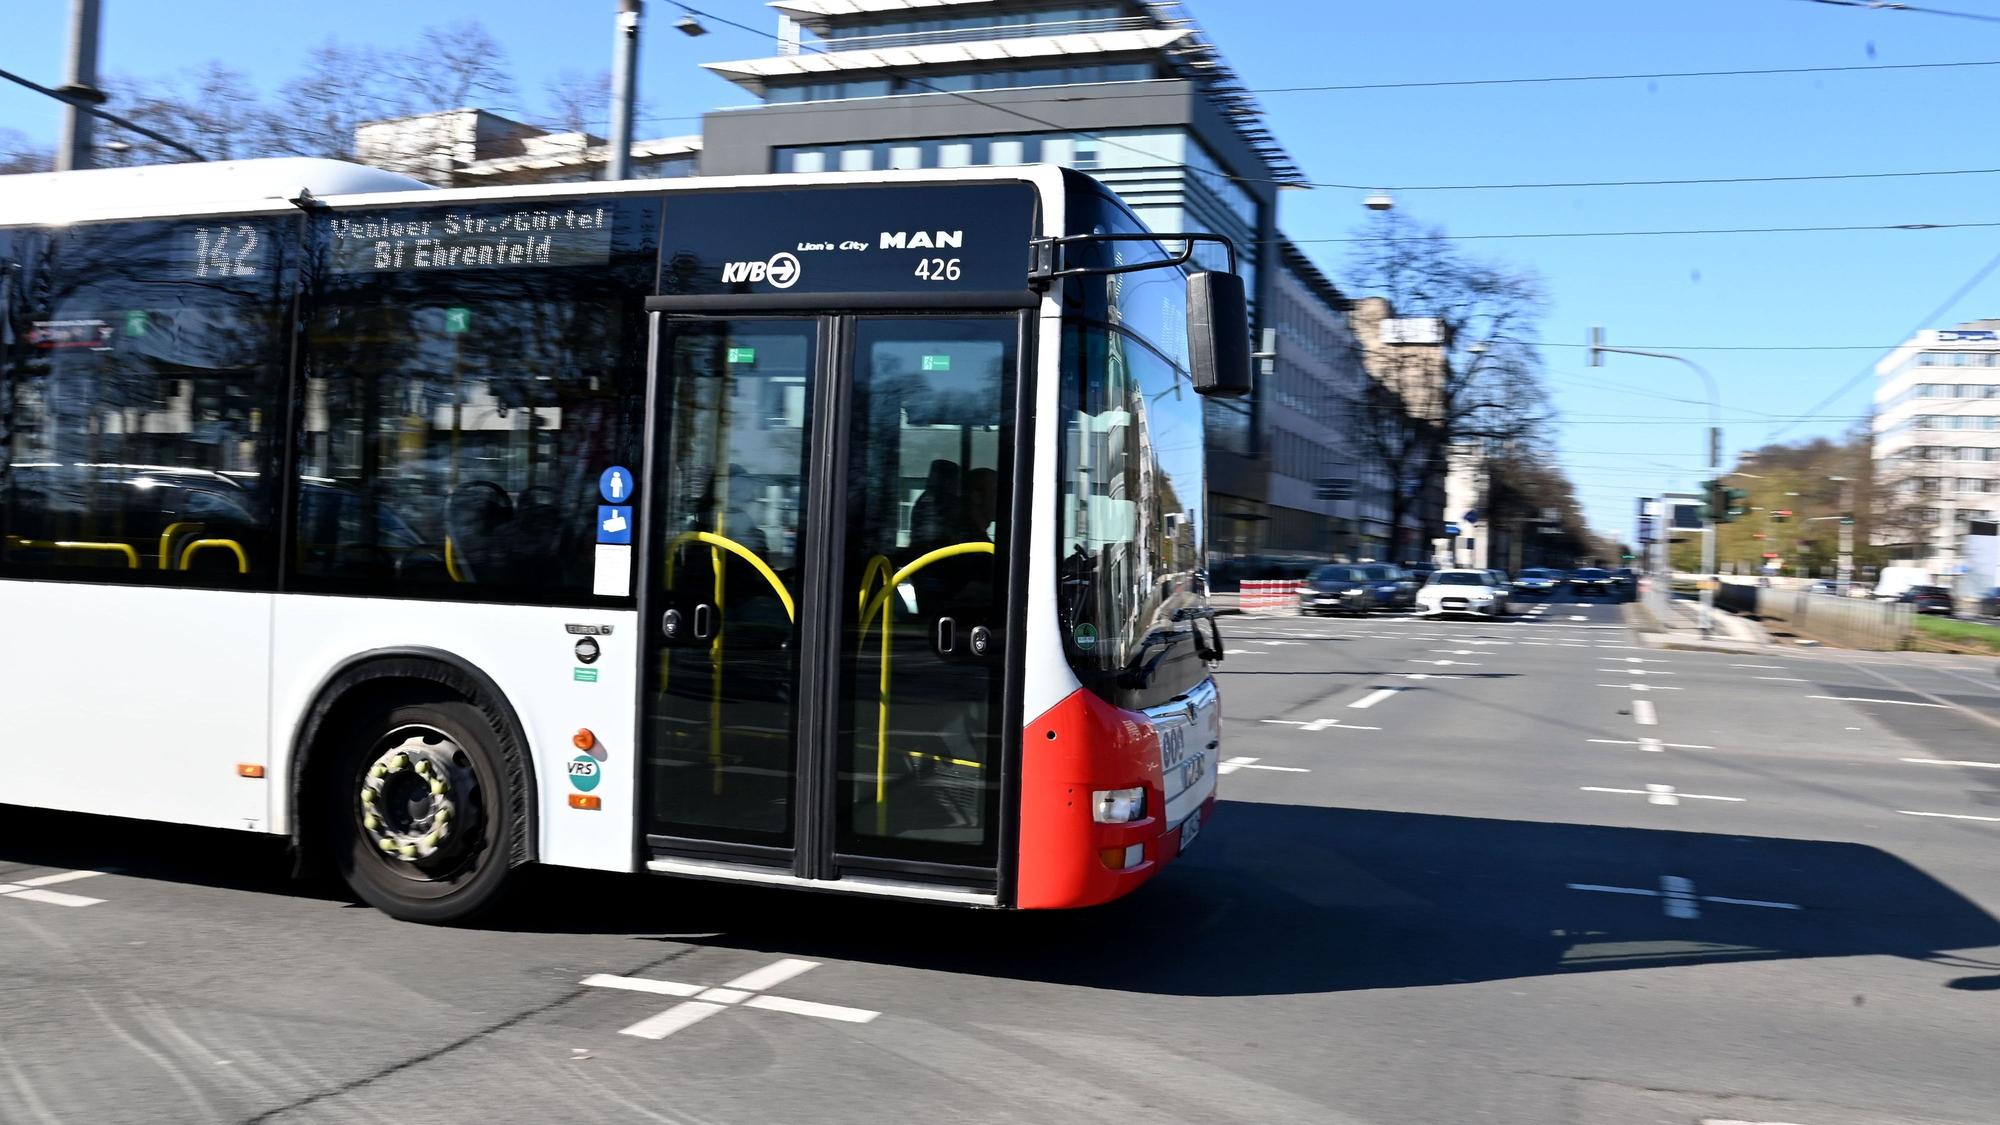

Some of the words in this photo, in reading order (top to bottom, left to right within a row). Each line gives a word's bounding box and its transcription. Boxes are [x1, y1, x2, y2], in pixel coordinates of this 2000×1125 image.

[331, 217, 432, 239] Venloer
[797, 241, 835, 251] Lion's
[839, 240, 869, 252] City
[880, 230, 963, 249] MAN
[195, 226, 258, 276] 142
[414, 235, 552, 267] Ehrenfeld
[721, 260, 768, 283] KVB
[914, 258, 961, 281] 426
[601, 624, 610, 634] 6
[567, 761, 593, 775] VRS
